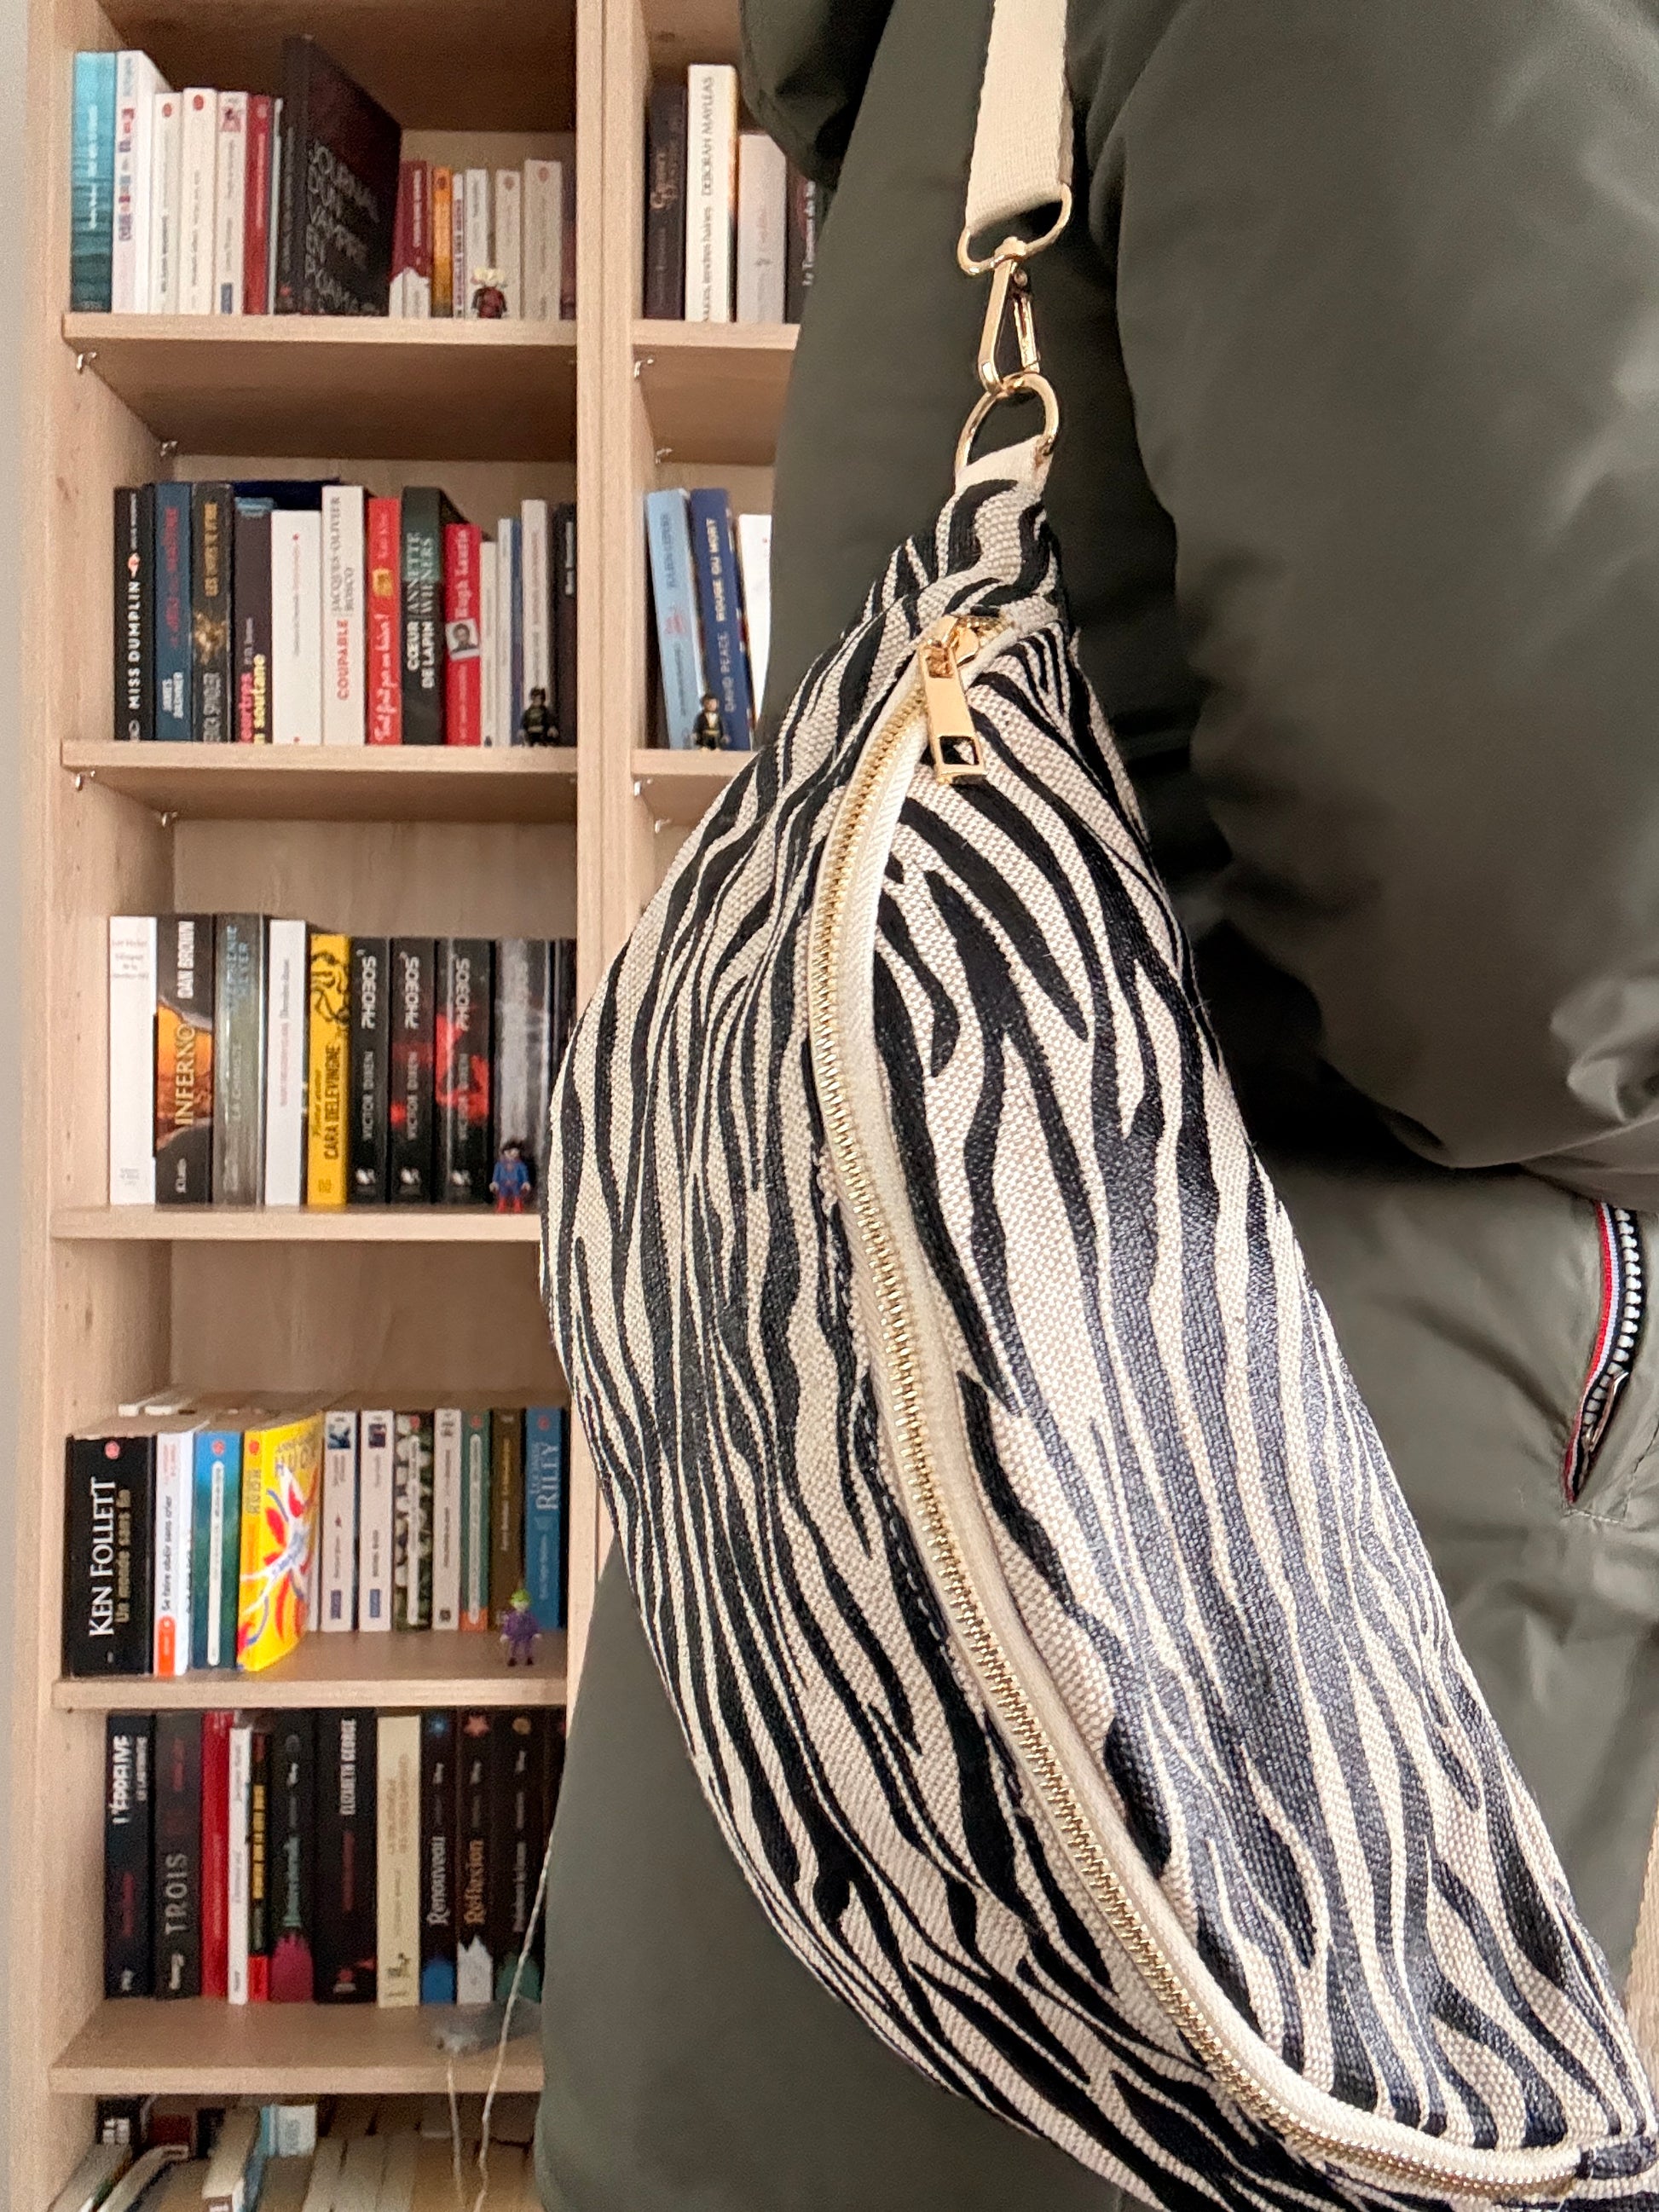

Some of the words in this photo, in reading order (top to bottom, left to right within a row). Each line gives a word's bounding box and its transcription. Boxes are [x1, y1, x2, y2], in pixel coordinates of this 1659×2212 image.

[456, 529, 470, 575] Laurie
[706, 517, 720, 553] MORT
[408, 532, 420, 612] ANNETTE
[420, 537, 433, 613] WIENERS
[128, 580, 141, 661] DUMPLIN
[457, 580, 473, 617] Hugh
[712, 578, 726, 622] ROUGE
[337, 620, 350, 700] COUPABLE
[421, 621, 435, 666] LAPIN
[717, 631, 731, 673] PEACE
[128, 667, 141, 709] MISS
[249, 655, 266, 728] soutane
[421, 667, 435, 689] DE
[721, 676, 735, 712] DAVID
[239, 673, 252, 742] eurtres
[177, 921, 195, 969] BROWN
[177, 971, 194, 999] DAN
[173, 1023, 196, 1126] INFERNO
[324, 1043, 341, 1122] DELEVINGNE
[324, 1124, 340, 1159] CARA
[362, 1094, 374, 1141] VICTOR
[535, 1442, 559, 1510] RILEY
[89, 1476, 115, 1577] FOLLETT
[89, 1585, 114, 1637] KEN
[161, 1599, 171, 1611] Se
[165, 1853, 188, 1935] TROIS
[428, 1836, 451, 1926] Renouveau
